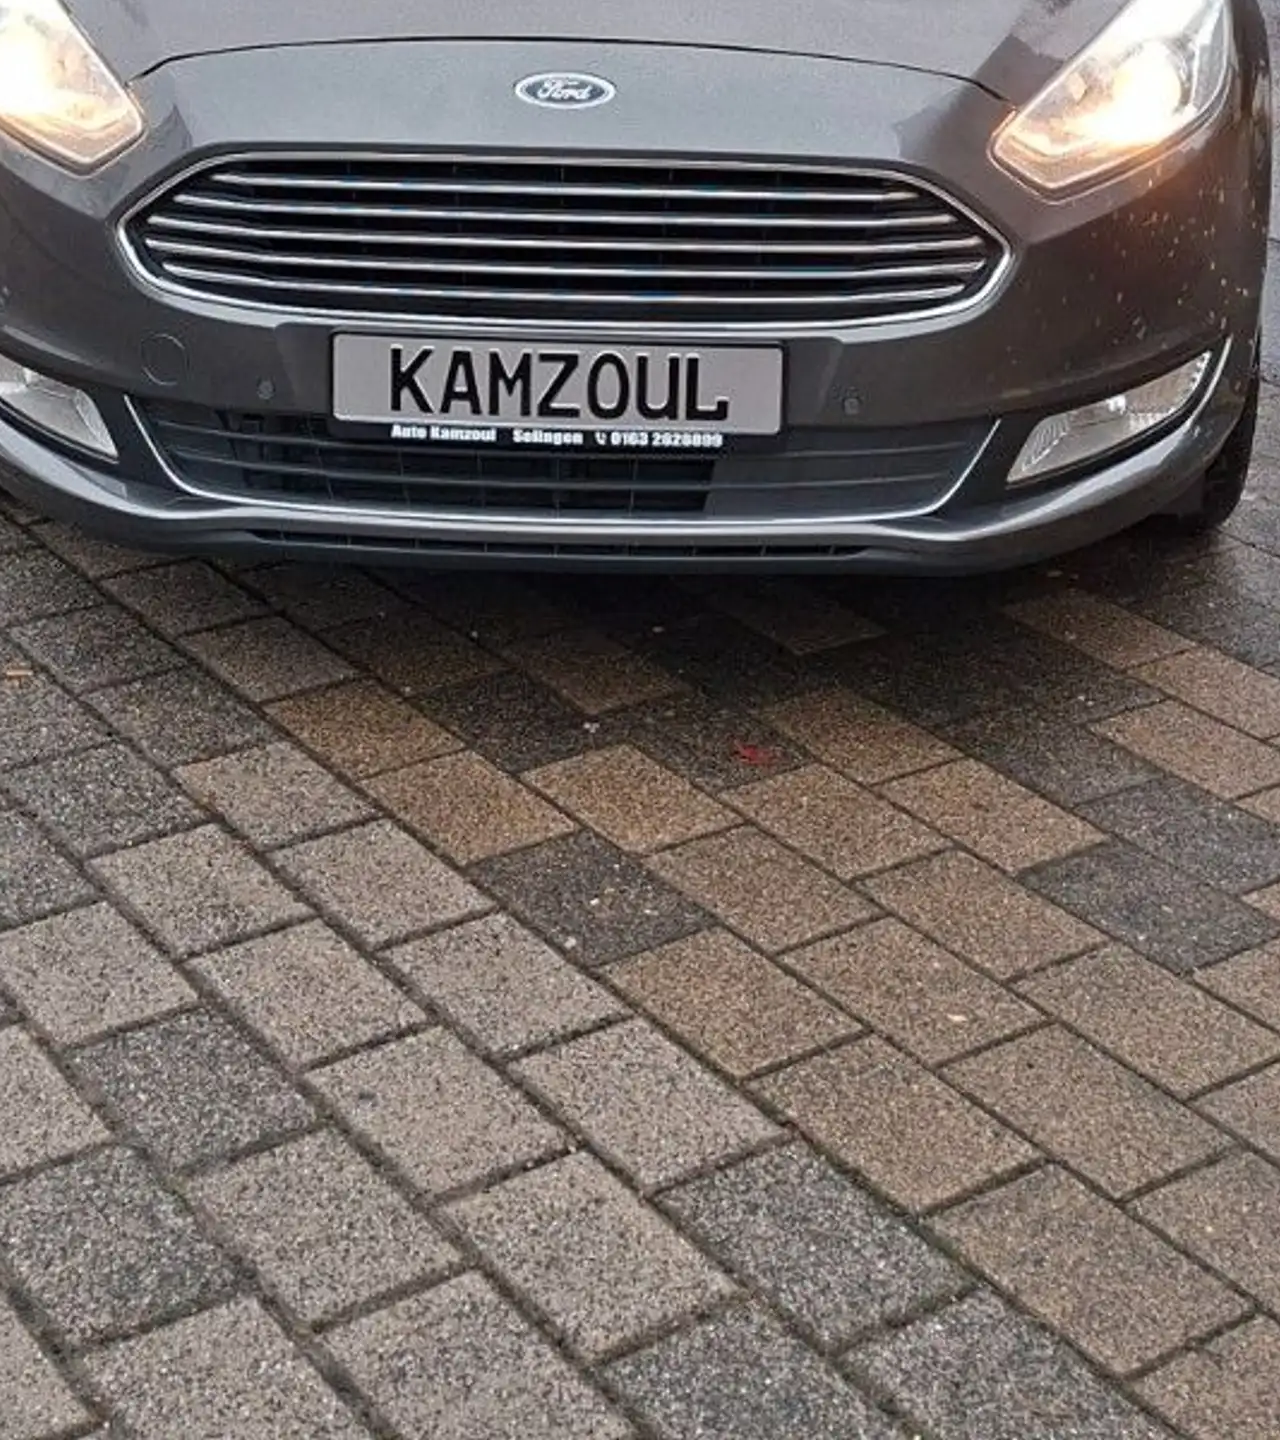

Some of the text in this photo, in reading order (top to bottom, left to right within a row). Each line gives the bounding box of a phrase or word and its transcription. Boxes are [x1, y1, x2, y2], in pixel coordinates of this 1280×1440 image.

[537, 79, 593, 101] Ford
[389, 347, 729, 422] KAMZOUL
[391, 423, 427, 440] Auto
[430, 425, 497, 442] Kamzoul
[512, 427, 583, 446] Solingen
